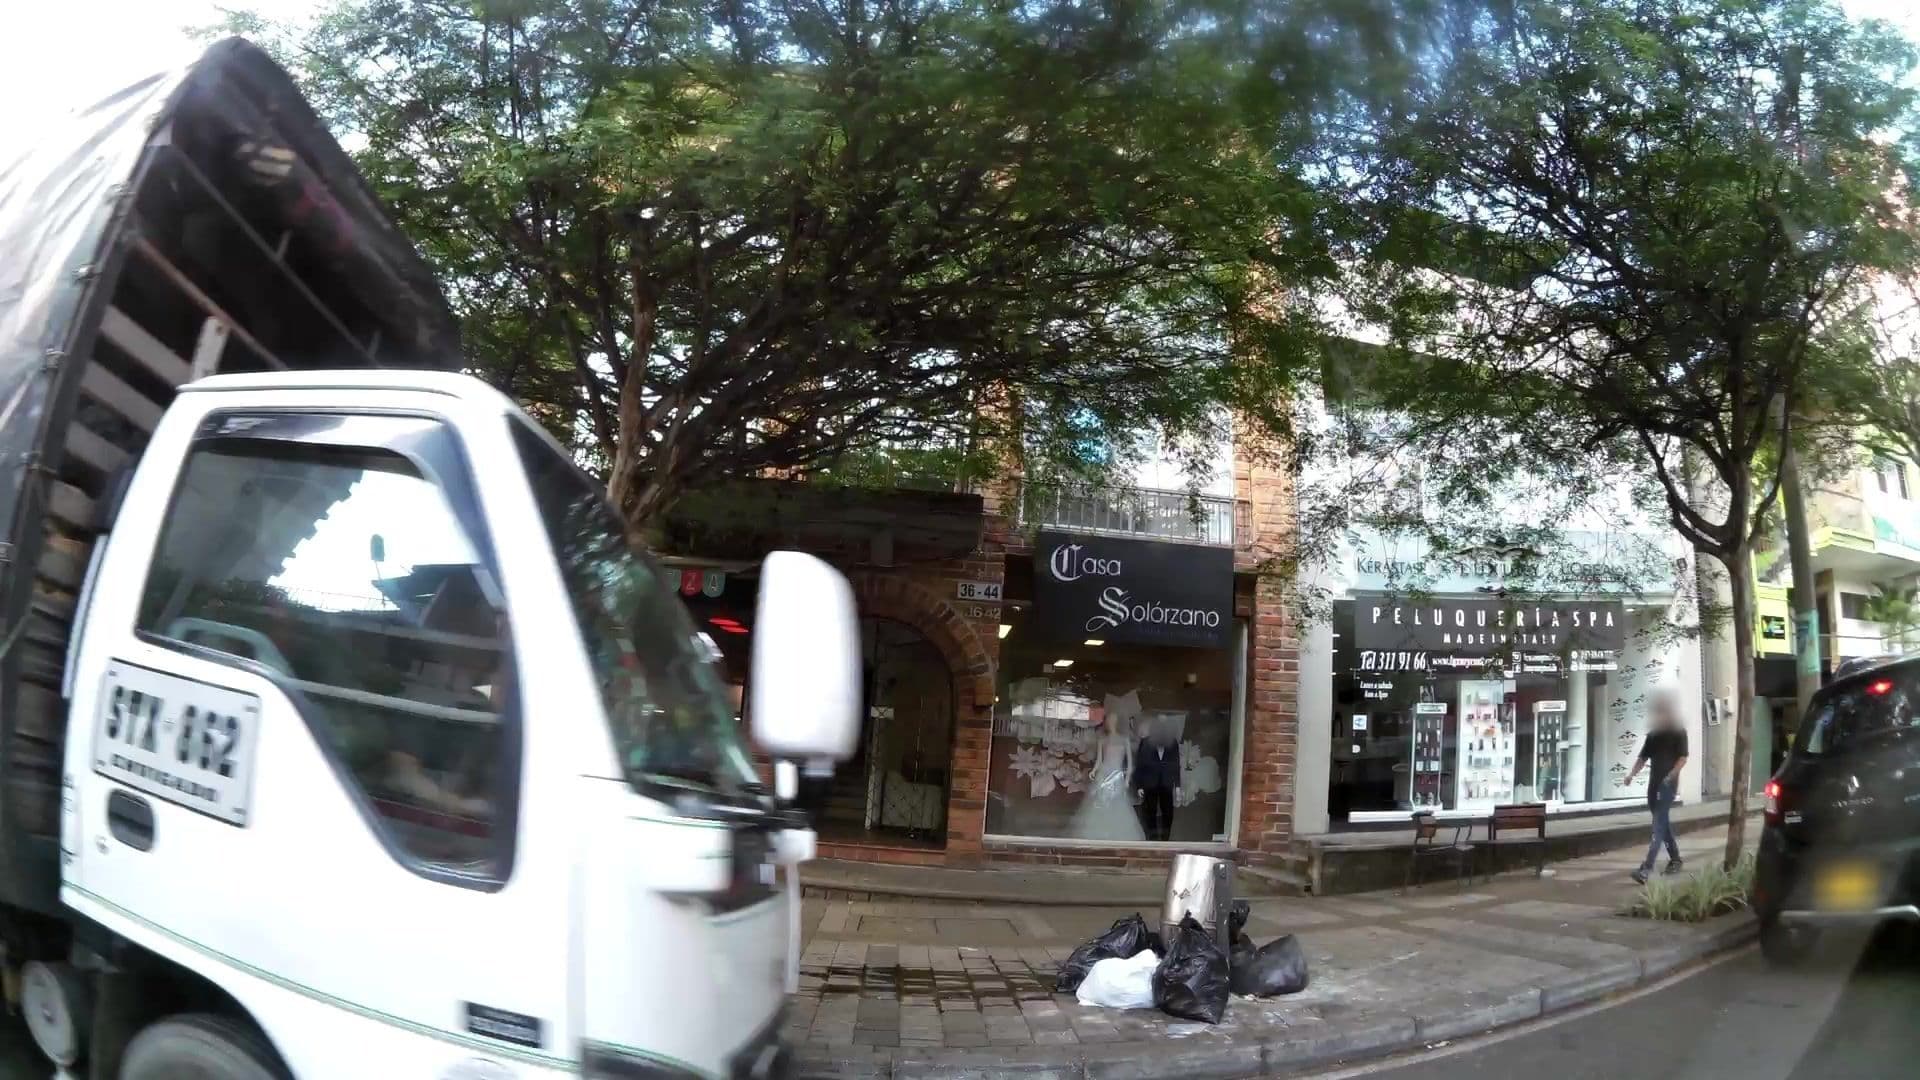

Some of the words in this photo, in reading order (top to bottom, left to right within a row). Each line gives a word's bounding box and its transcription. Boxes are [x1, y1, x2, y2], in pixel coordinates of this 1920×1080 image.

[1050, 543, 1122, 582] Casa
[1085, 586, 1220, 632] Solórzano
[1372, 606, 1560, 628] PELUQUERÍA
[1573, 610, 1615, 628] SPA
[1443, 632, 1485, 645] MADE
[1491, 633, 1507, 645] IN
[1360, 650, 1377, 670] Tel
[1377, 651, 1396, 670] 311
[1398, 652, 1411, 670] 91
[1413, 651, 1427, 670] 66
